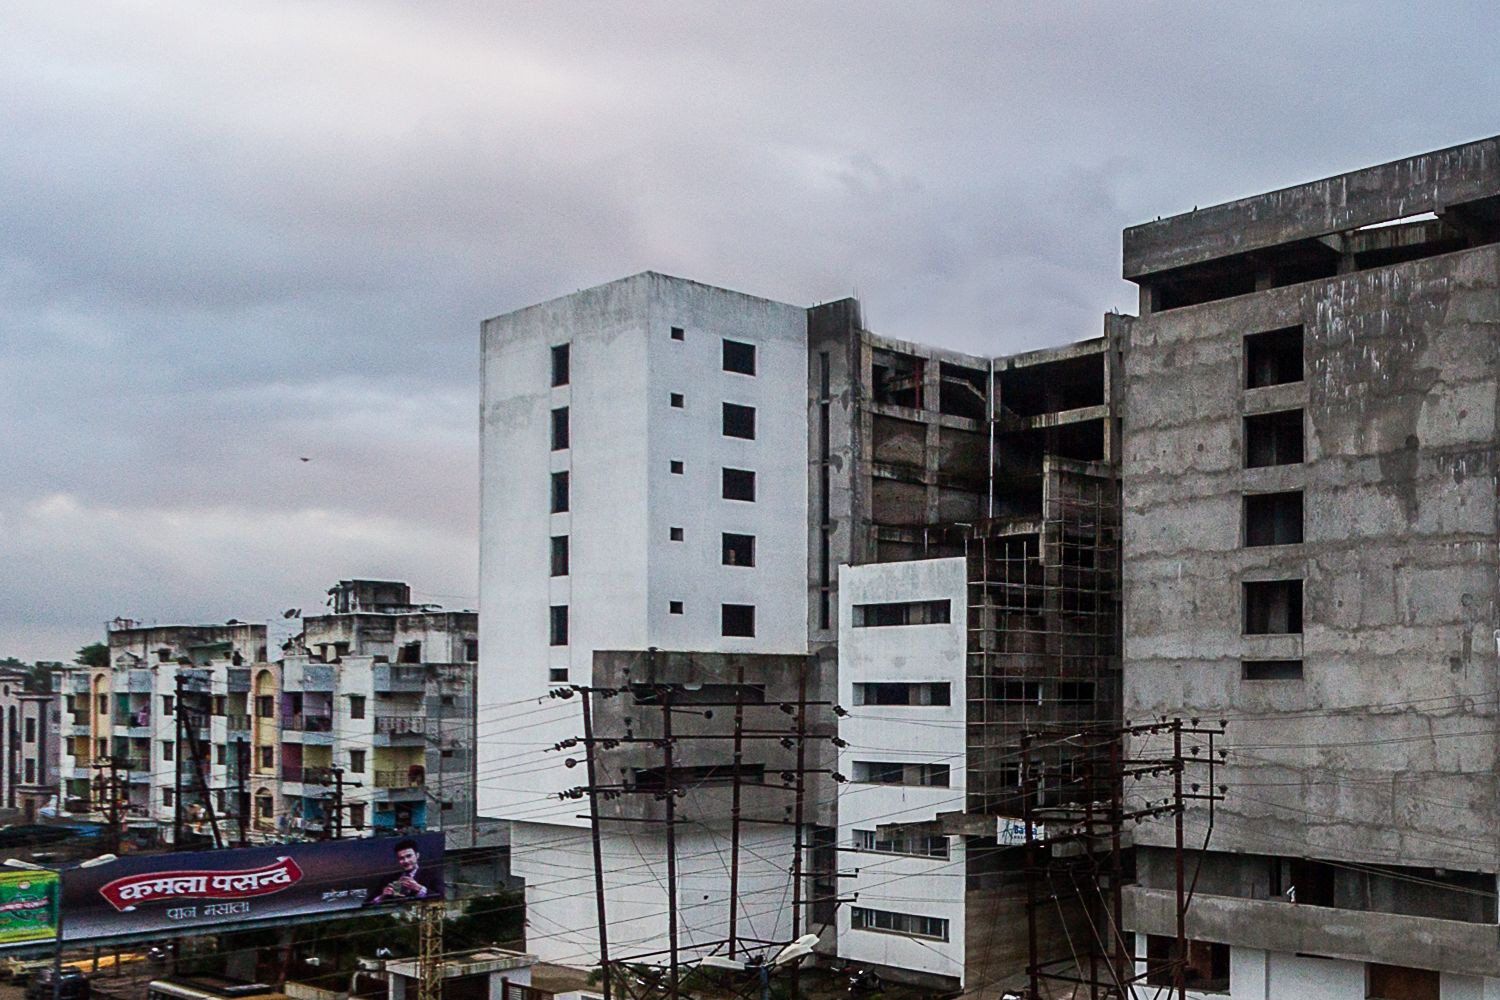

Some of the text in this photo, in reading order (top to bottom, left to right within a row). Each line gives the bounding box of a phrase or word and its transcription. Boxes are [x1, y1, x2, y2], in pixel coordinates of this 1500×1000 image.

[118, 867, 292, 899] कमला पसन्द
[166, 902, 250, 920] पान मसाला
